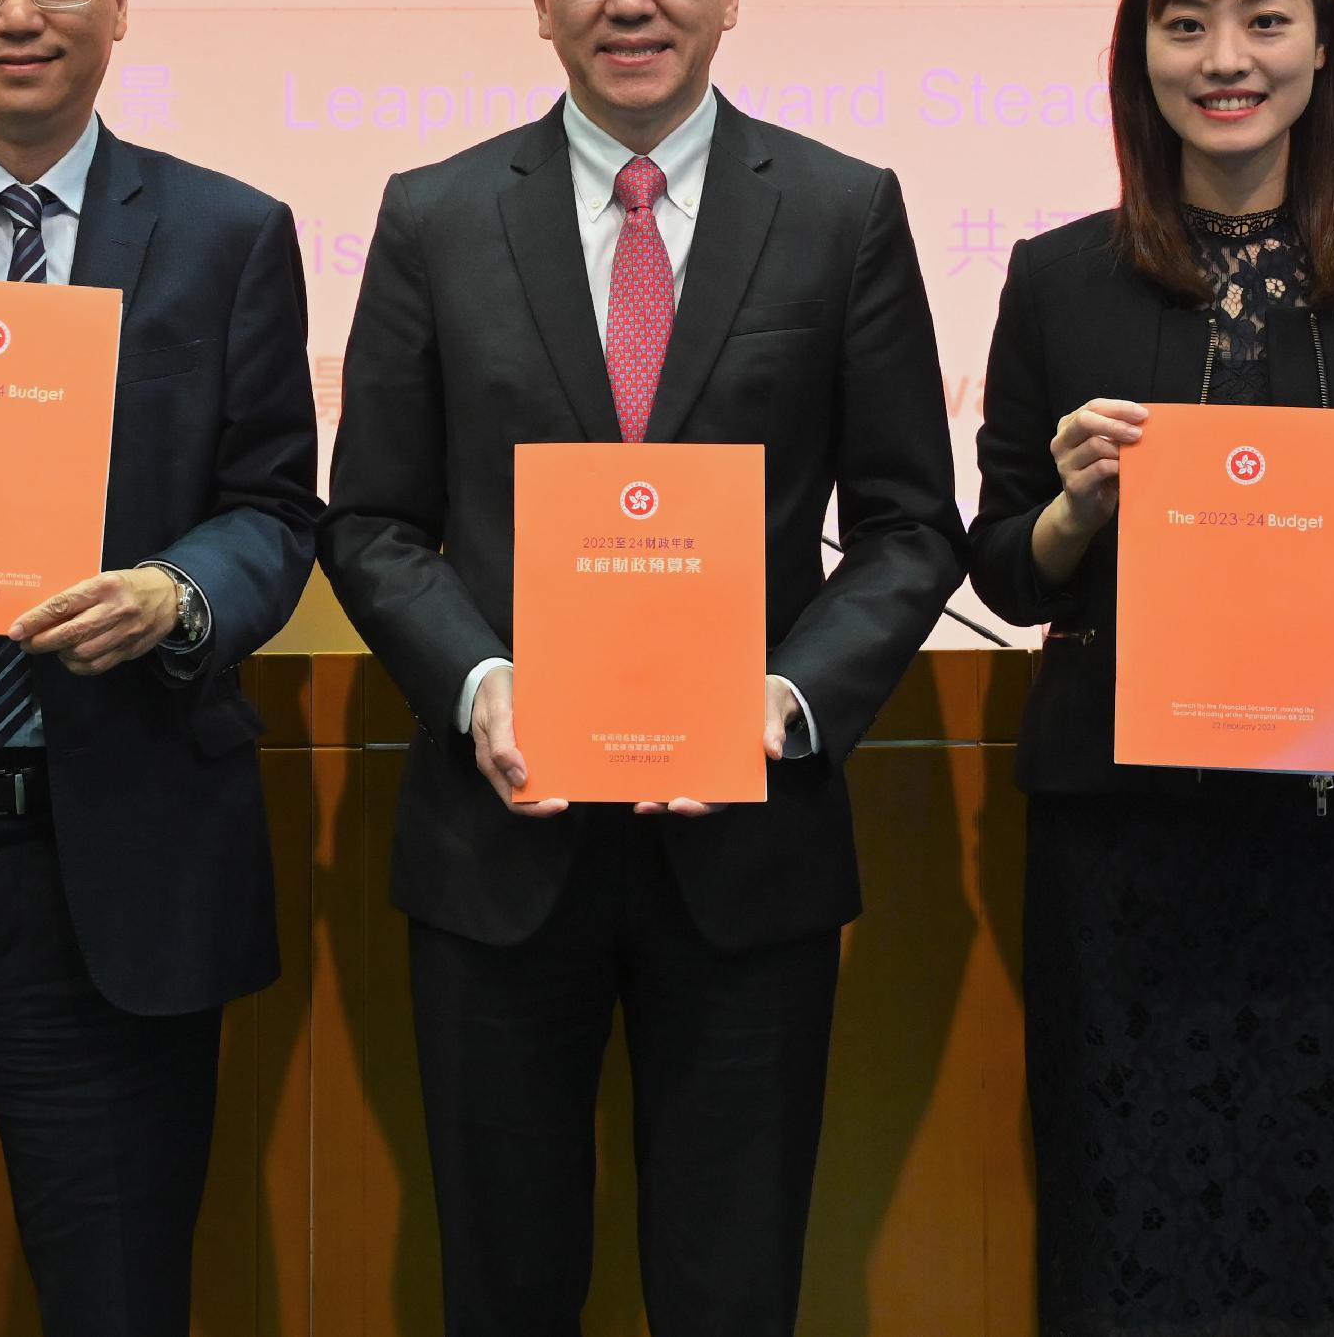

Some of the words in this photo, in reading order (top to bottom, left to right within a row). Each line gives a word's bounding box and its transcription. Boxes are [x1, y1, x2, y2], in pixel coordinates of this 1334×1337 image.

[8, 384, 65, 403] Budget
[1167, 510, 1195, 525] The
[1198, 511, 1265, 527] 2023-24
[1267, 513, 1324, 531] Budget
[582, 536, 695, 550] 2023至24財政年度
[576, 556, 703, 574] 政府財政預算案
